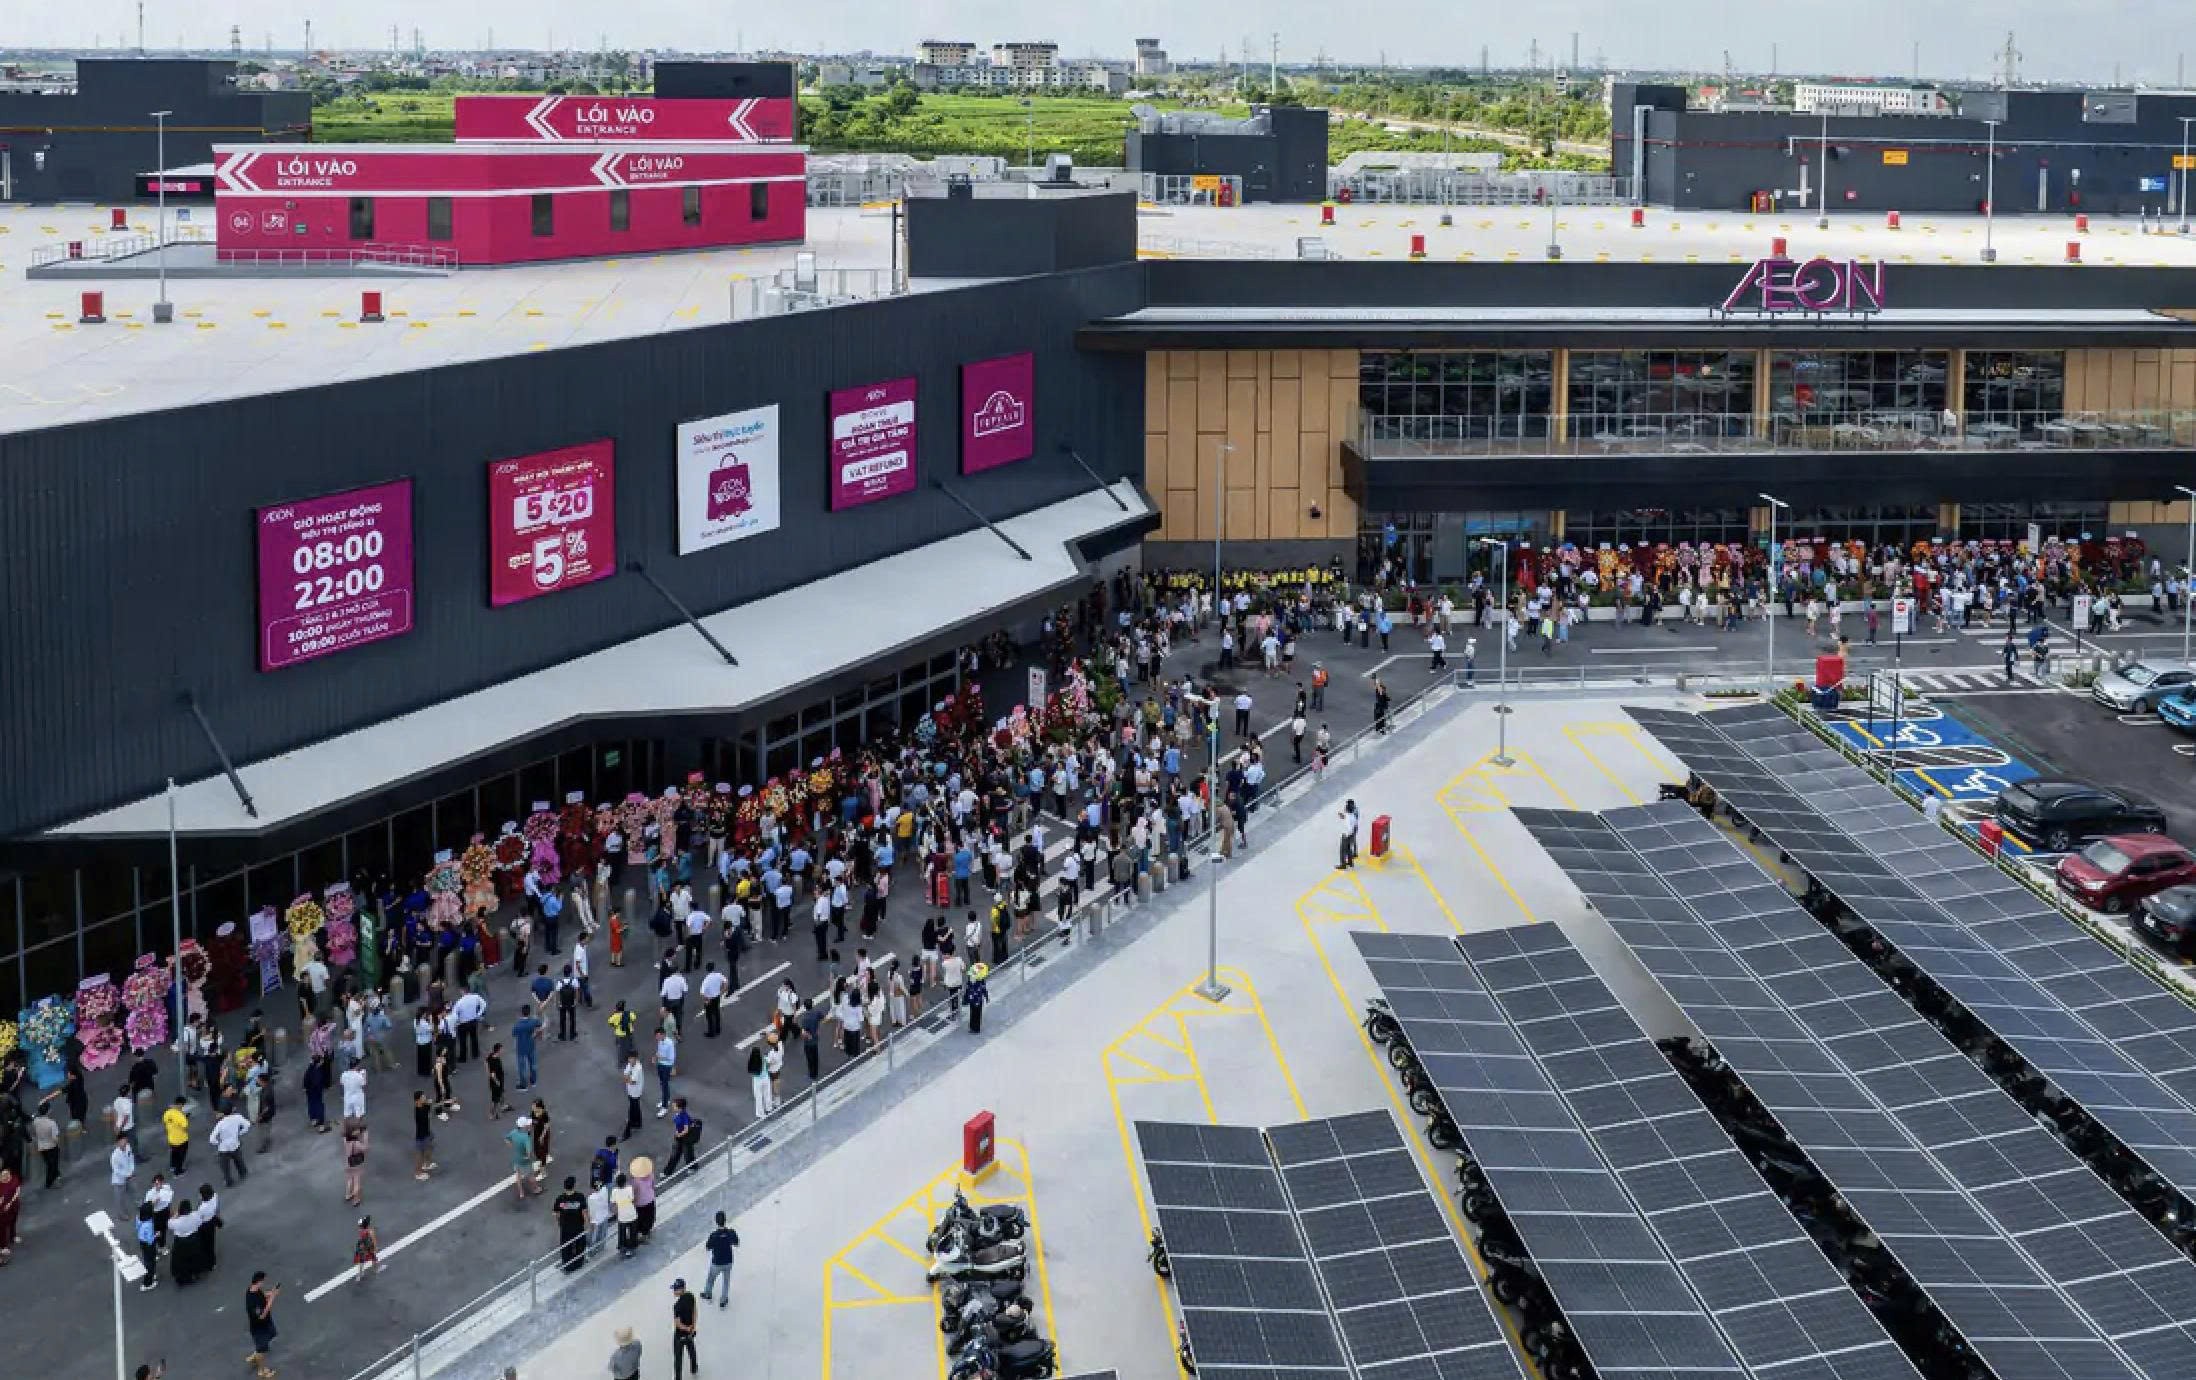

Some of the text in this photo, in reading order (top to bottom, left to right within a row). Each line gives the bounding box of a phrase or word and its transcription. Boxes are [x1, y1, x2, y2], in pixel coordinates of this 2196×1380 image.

[577, 125, 637, 135] ENTRANCE
[629, 171, 668, 180] ENTRANCE
[847, 456, 904, 479] VAT REFUND
[527, 494, 543, 520] 5
[558, 490, 589, 518] 20
[293, 530, 384, 573] 08:00
[294, 564, 385, 610] 22:00
[288, 625, 323, 644] 10:00
[301, 634, 336, 654] 09:00
